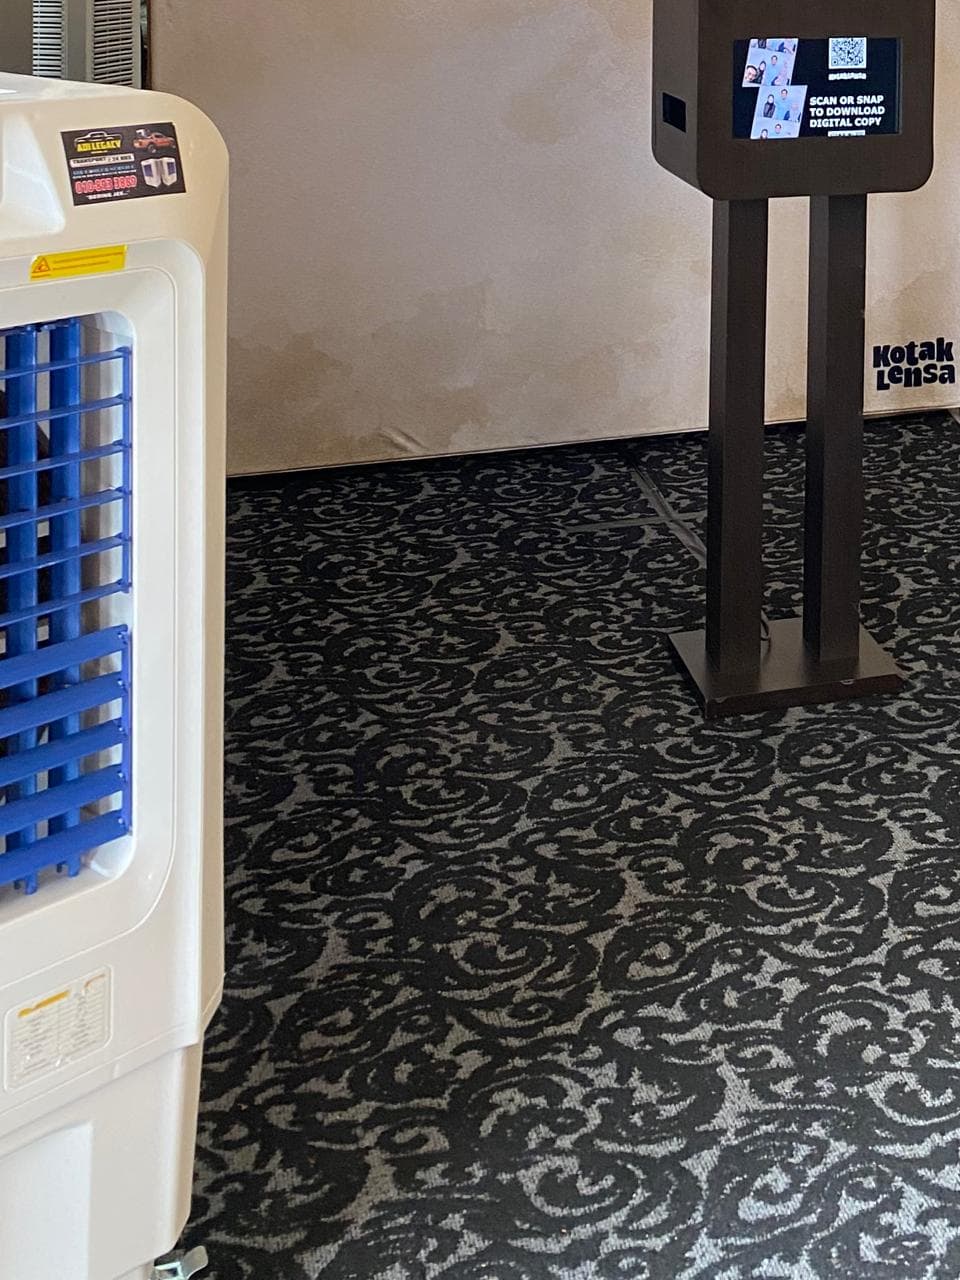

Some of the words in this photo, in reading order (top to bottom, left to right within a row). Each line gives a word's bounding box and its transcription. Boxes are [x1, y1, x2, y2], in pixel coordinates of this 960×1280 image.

[809, 96, 837, 106] SCAN
[839, 95, 855, 105] OR
[856, 94, 884, 104] SNAP
[809, 107, 824, 117] TO
[826, 106, 886, 116] DOWNLOAD
[809, 118, 853, 128] DIGITAL
[854, 117, 882, 127] COPY
[873, 337, 954, 368] Kotak
[877, 363, 955, 391] Lensa
